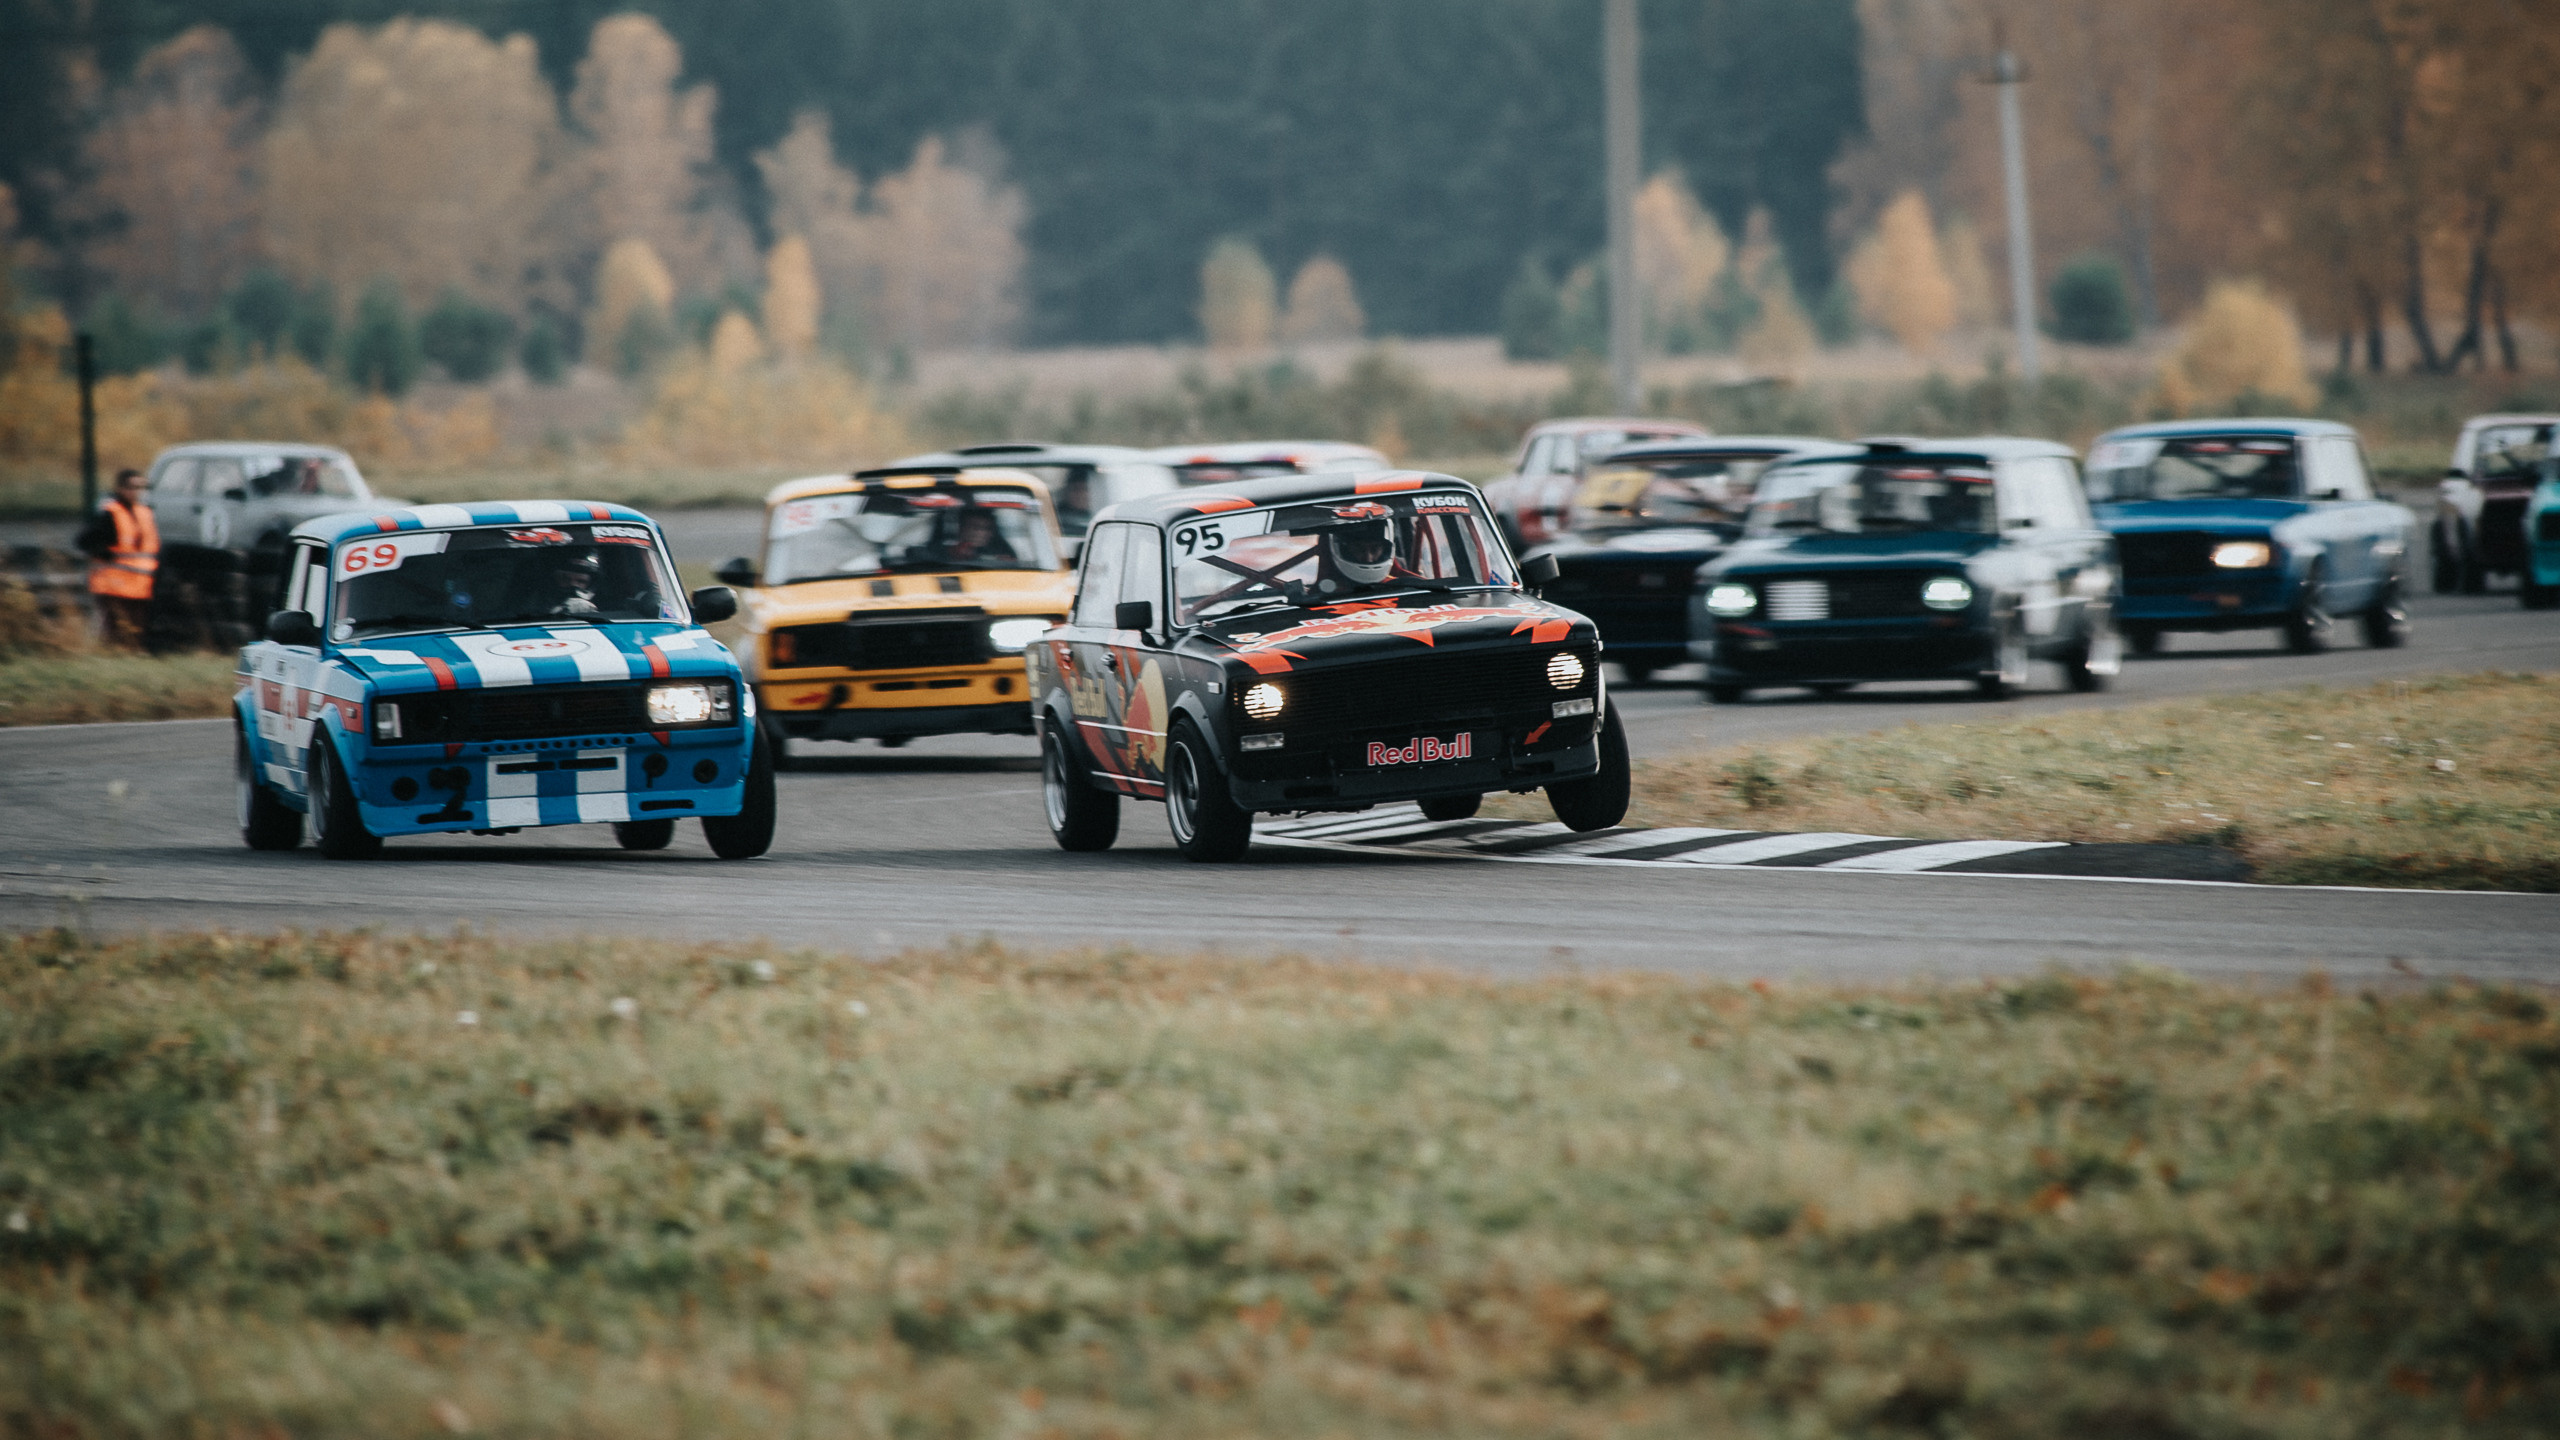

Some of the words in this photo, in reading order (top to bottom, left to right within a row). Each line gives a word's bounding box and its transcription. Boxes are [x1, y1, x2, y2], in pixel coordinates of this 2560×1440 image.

[1411, 495, 1468, 508] КУБОК
[1175, 523, 1224, 556] 95
[344, 543, 397, 573] 69
[1367, 737, 1419, 766] Red
[1421, 732, 1472, 762] Bull
